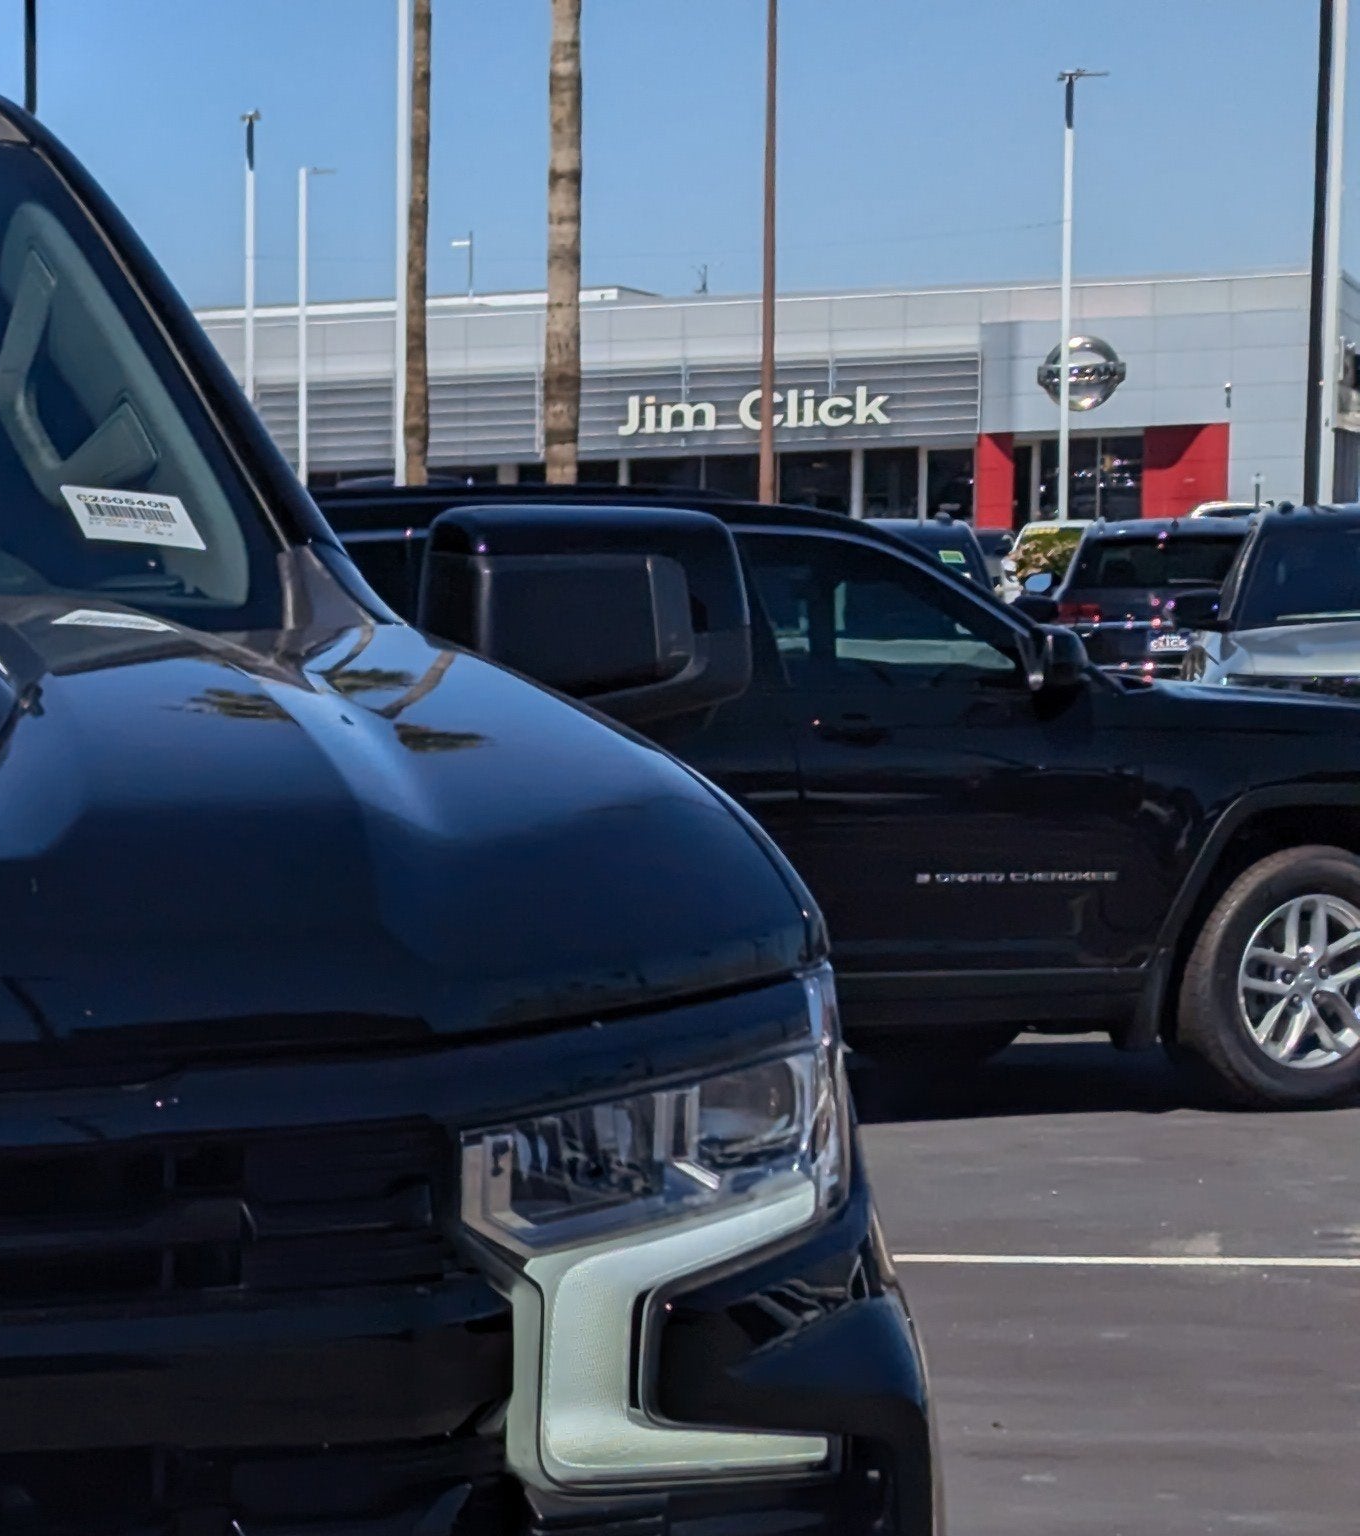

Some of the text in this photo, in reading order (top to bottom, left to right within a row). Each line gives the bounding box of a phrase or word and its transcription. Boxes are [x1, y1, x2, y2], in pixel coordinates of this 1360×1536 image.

[618, 386, 892, 436] Jim Click
[1009, 871, 1119, 882] CHEROKEE
